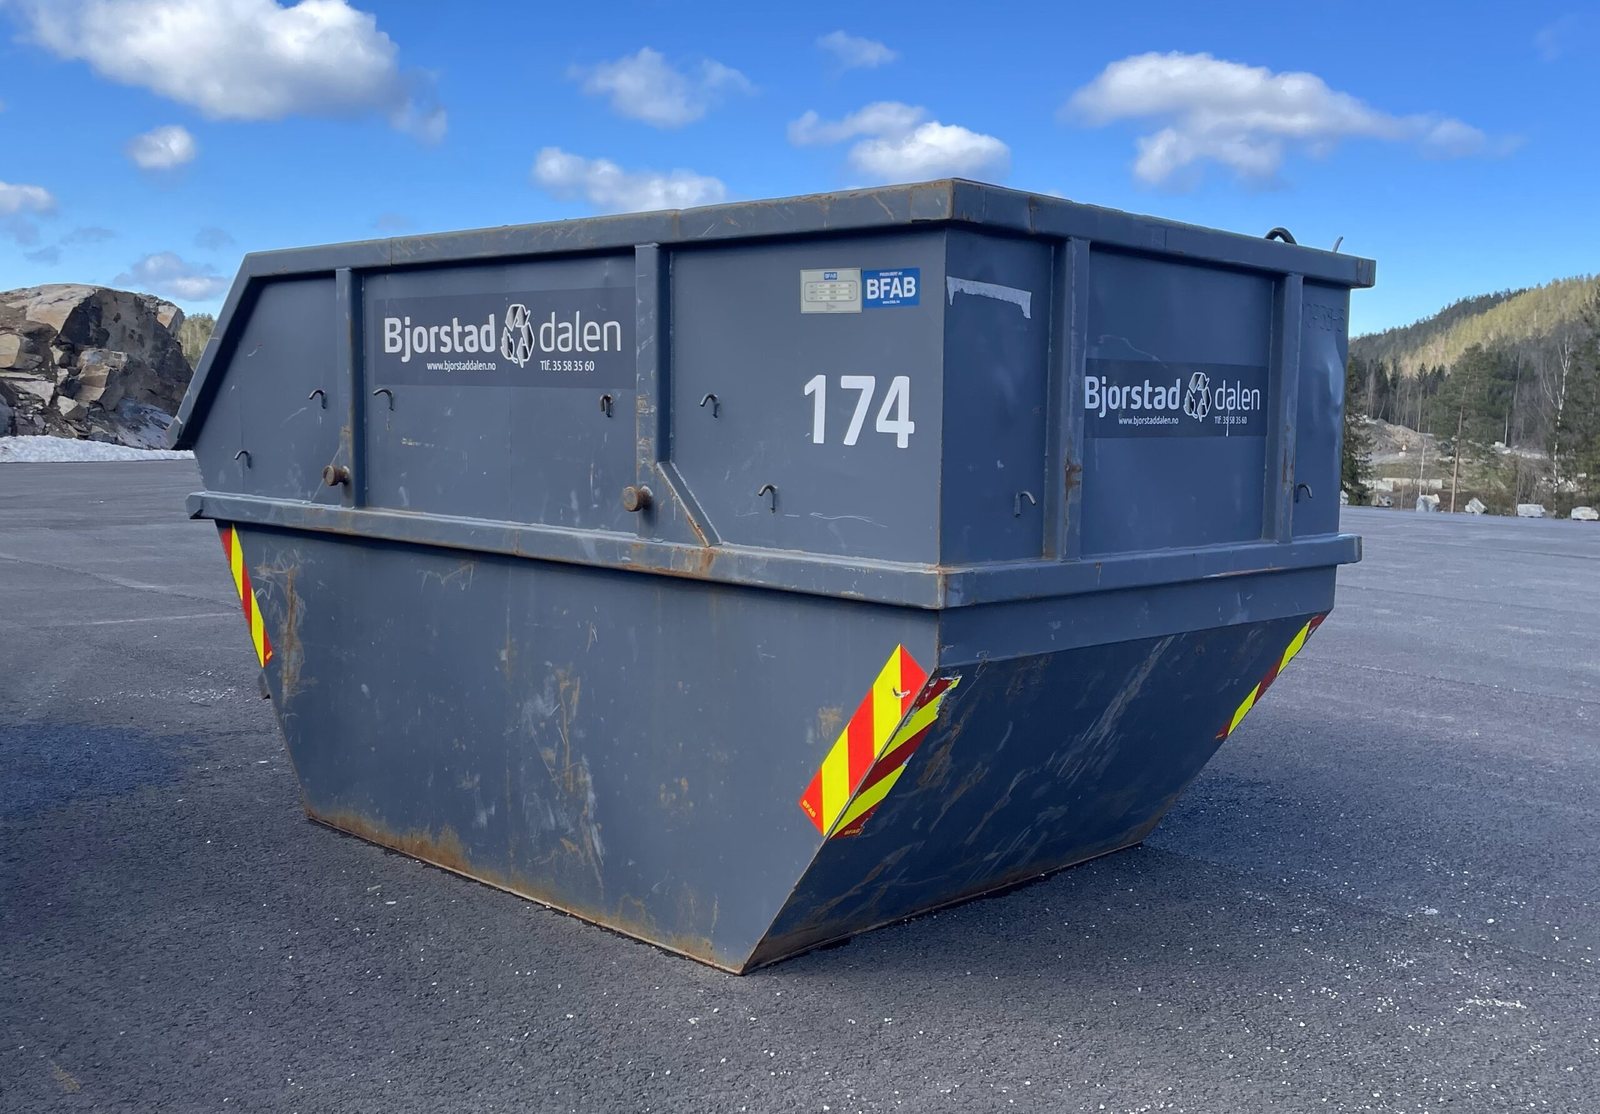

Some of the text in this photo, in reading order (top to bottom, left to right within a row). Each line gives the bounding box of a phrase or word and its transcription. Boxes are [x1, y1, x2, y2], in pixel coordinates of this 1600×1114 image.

[866, 276, 916, 300] BFAB
[384, 310, 622, 362] Bjorstad dalen
[426, 359, 496, 372] www.bjorstaddalen.no
[552, 360, 562, 371] 35
[562, 360, 573, 371] 58
[573, 360, 583, 371] 35
[584, 360, 595, 371] 60
[1084, 375, 1261, 418] Bjorstad dalen
[804, 374, 915, 449] 174
[1118, 415, 1179, 426] www.bjorstaddalen.no
